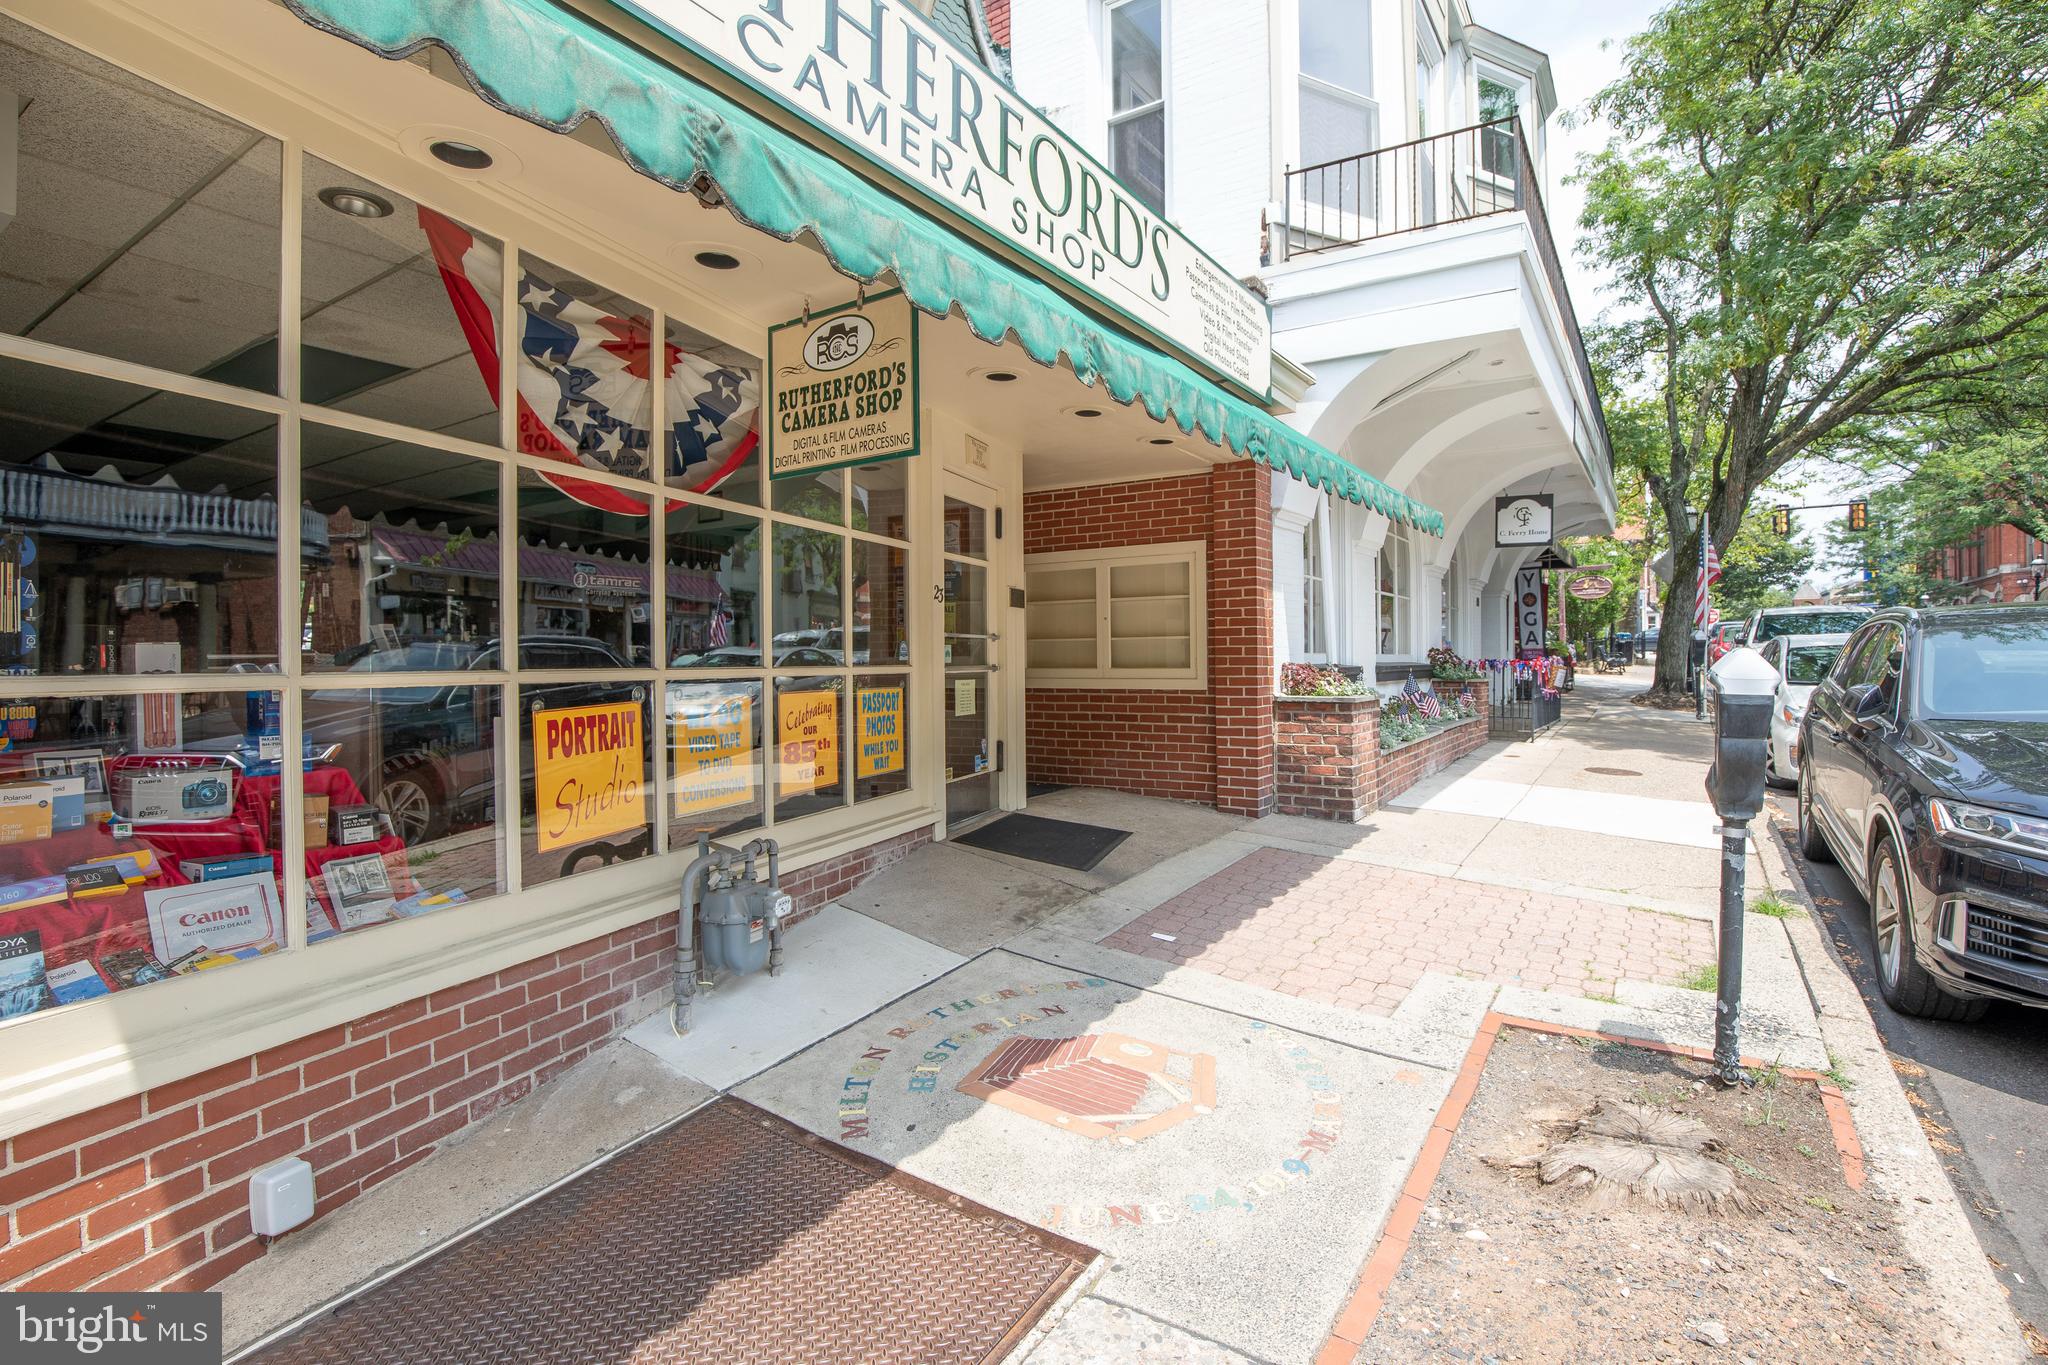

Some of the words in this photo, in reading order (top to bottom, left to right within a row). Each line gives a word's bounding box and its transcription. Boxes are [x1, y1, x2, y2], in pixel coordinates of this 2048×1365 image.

[737, 14, 987, 211] CAMERA
[1011, 197, 1106, 281] SHOP
[1195, 257, 1229, 294] Enlargements
[1185, 265, 1209, 293] Passport
[1209, 285, 1226, 306] Photos
[1231, 301, 1241, 317] Film
[1191, 286, 1215, 312] Cameras
[1221, 309, 1232, 324] Film
[1200, 306, 1216, 328] Video
[1222, 323, 1233, 340] Film
[817, 333, 858, 365] RCS
[1203, 326, 1221, 346] Digital
[1222, 338, 1235, 357] Head
[1203, 341, 1214, 357] Old
[1215, 348, 1232, 369] Photos
[1233, 361, 1250, 381] Copied
[778, 361, 906, 413] RUTHERFORD'S
[781, 403, 850, 434] CAMERA
[855, 387, 903, 419] SHOP
[793, 435, 821, 451] DIGITAL
[822, 433, 829, 445] &
[829, 430, 846, 444] FILM
[848, 421, 887, 440] CAMERAS
[775, 451, 801, 469] DIGITAL
[802, 446, 836, 465] PRINTING
[840, 443, 858, 457] FILM
[859, 432, 911, 455] PROCESSING
[1508, 529, 1526, 537] Ferry
[589, 576, 641, 588] tamrac
[933, 584, 944, 603] 23
[785, 700, 832, 731] Celebrating
[862, 691, 900, 714] PASSPORT
[546, 710, 636, 760] PORTRAIT
[803, 725, 817, 735] OUR
[866, 714, 896, 737] PHOTOS
[688, 735, 716, 754] VIDEO
[718, 731, 741, 751] TAPE
[783, 737, 831, 764] 85th
[863, 741, 884, 758] WHILE
[885, 739, 899, 753] YOU
[698, 759, 710, 776] TO
[713, 755, 733, 775] DVD
[796, 765, 824, 780] YEAR
[873, 755, 890, 770] WAIT
[549, 754, 638, 839] Studio
[682, 777, 747, 803] CONVERSIONS
[84, 872, 102, 882] 100
[179, 904, 250, 928] Canon
[182, 924, 225, 938] AUTHORIZED
[226, 919, 252, 929] DEALER
[49, 969, 78, 981] Polaroid
[907, 1003, 1069, 1094] HISTORIAN
[838, 1045, 892, 1141] MILTON
[1040, 1202, 1180, 1229] JUNE
